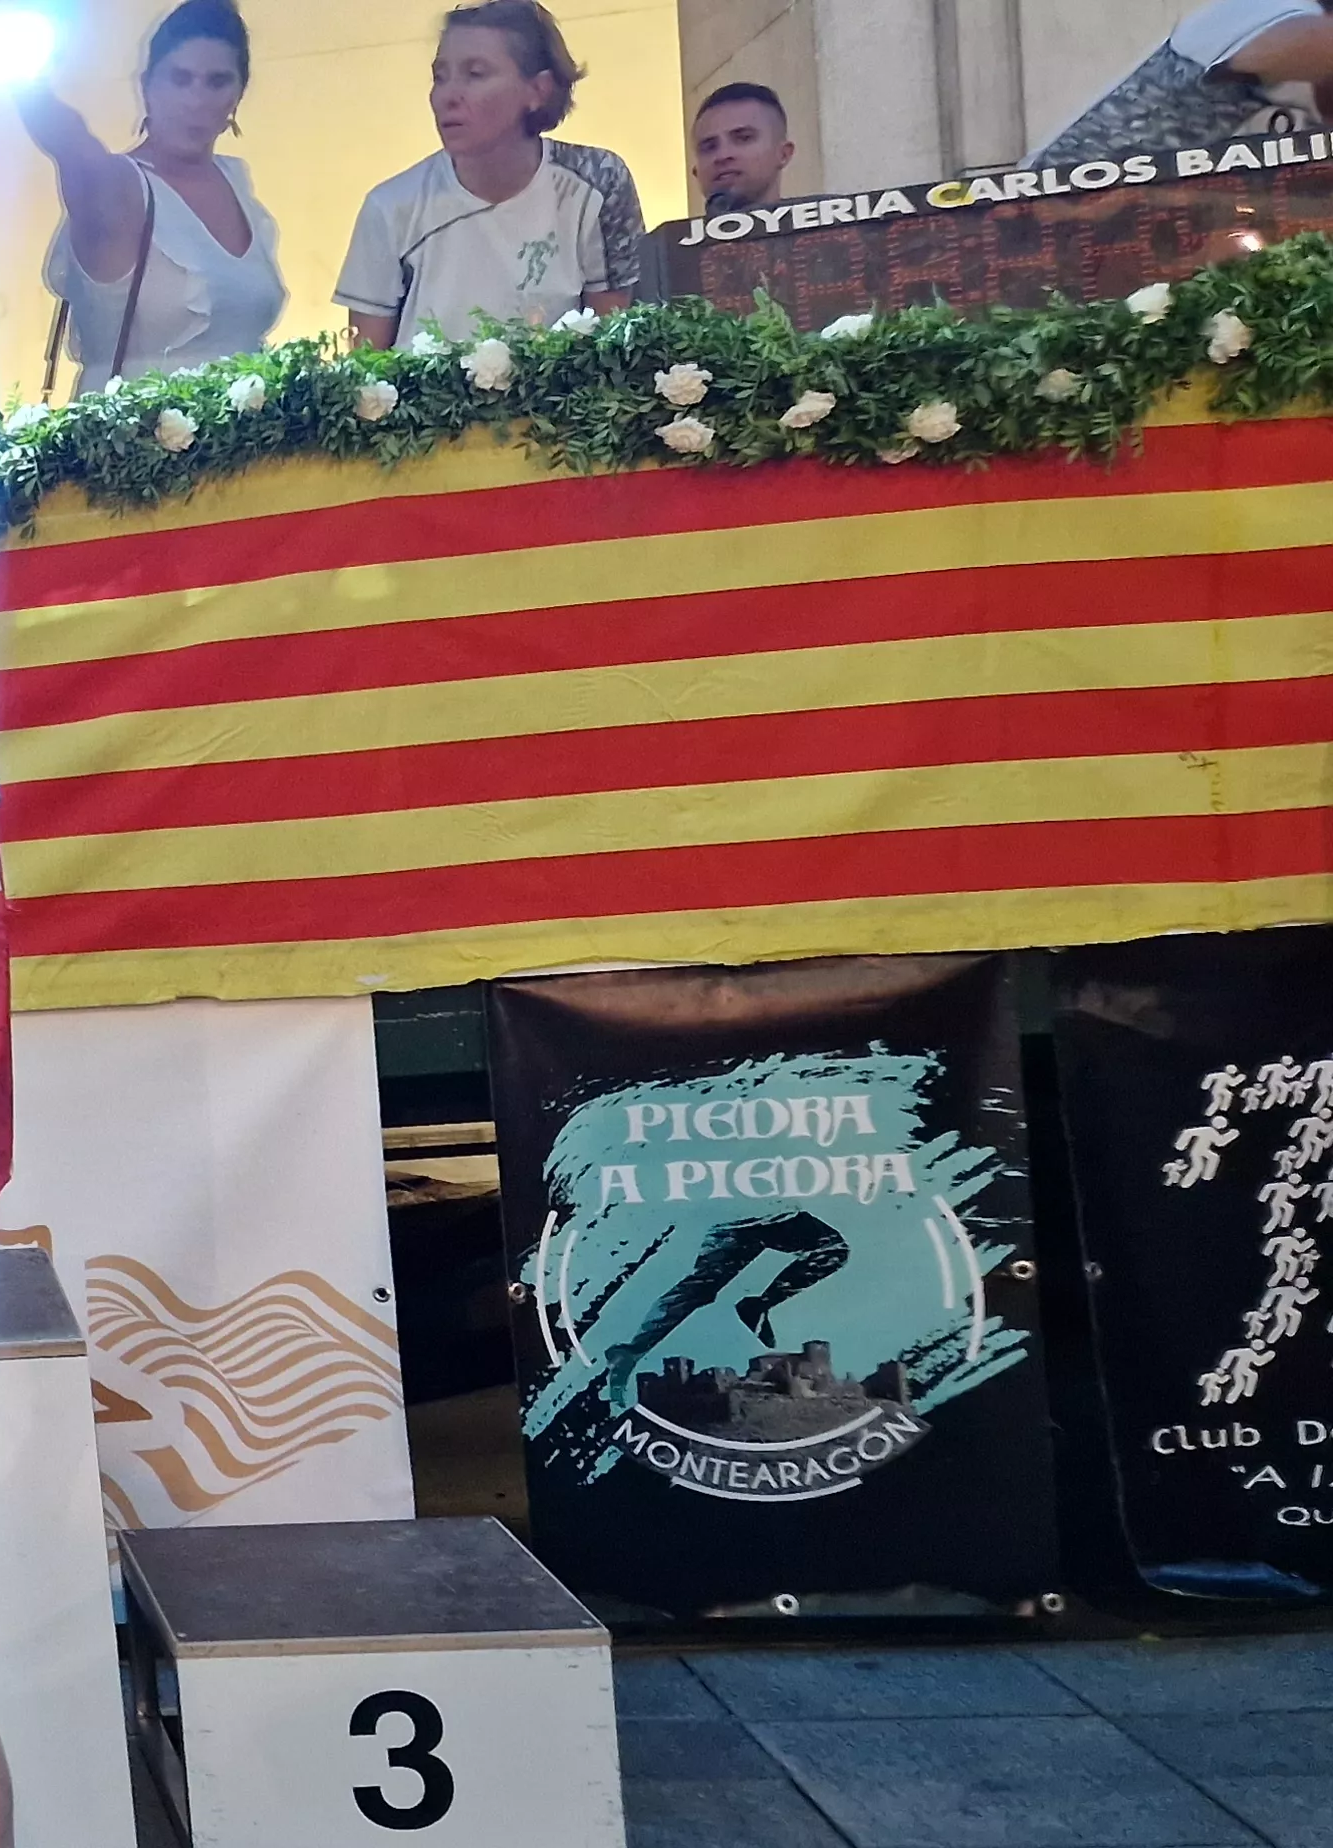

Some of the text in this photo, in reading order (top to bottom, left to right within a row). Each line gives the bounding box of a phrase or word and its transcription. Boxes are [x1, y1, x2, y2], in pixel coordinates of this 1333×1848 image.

[678, 132, 1333, 247] JOYERIA CARLOS BAILI
[623, 1094, 877, 1148] PIEDRA
[599, 1152, 916, 1205] A PIEDRA
[613, 1411, 926, 1490] MONTEARAGÓN
[1152, 1420, 1333, 1455] Club D
[349, 1689, 455, 1831] 3
